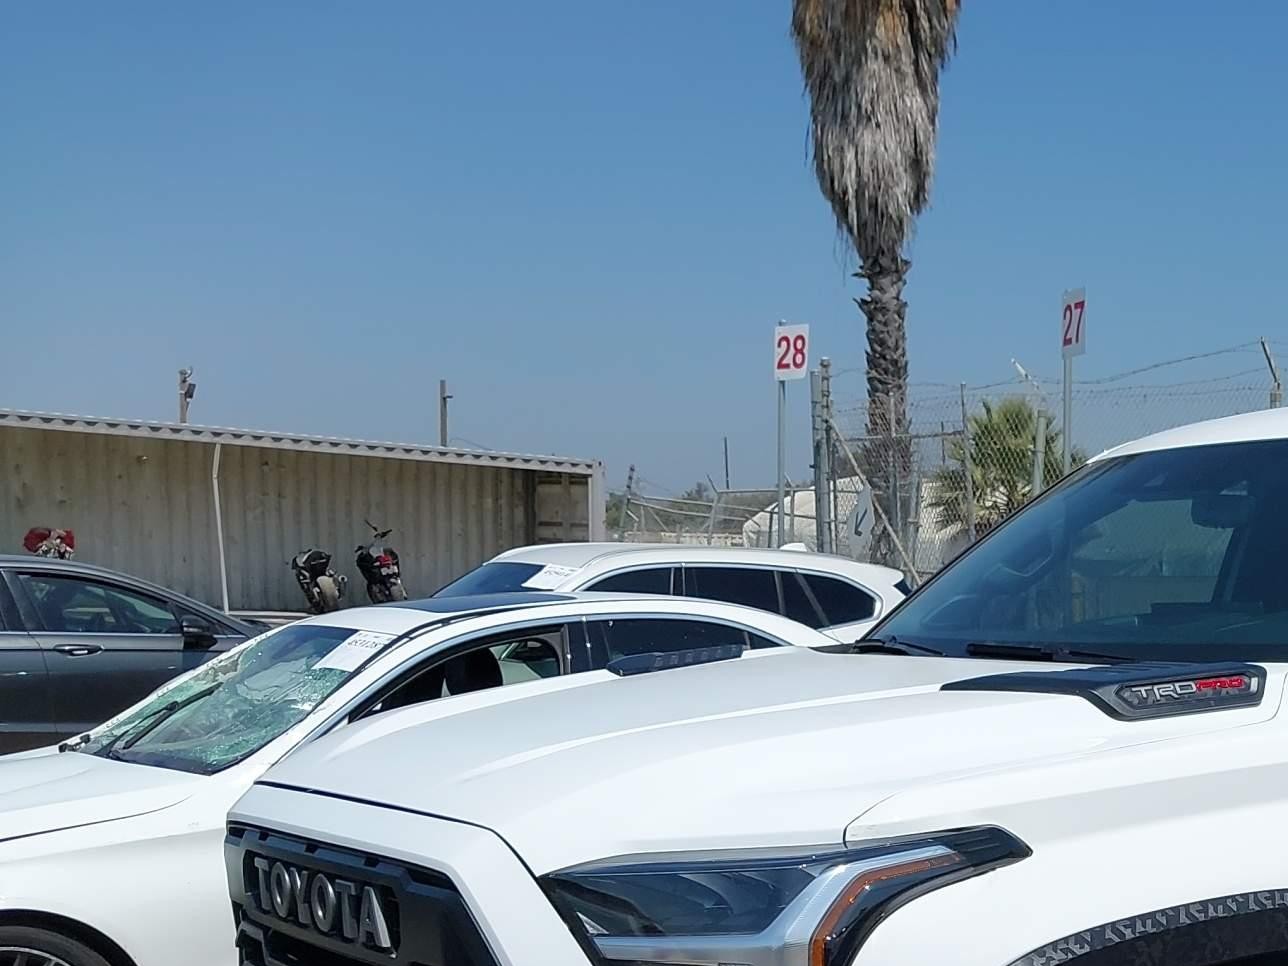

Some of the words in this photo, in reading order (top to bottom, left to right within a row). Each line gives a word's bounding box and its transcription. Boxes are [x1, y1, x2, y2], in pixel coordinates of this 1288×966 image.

[1063, 300, 1085, 347] 27
[777, 334, 806, 370] 28
[1131, 681, 1197, 703] TRD
[254, 856, 392, 948] TOYOTA
